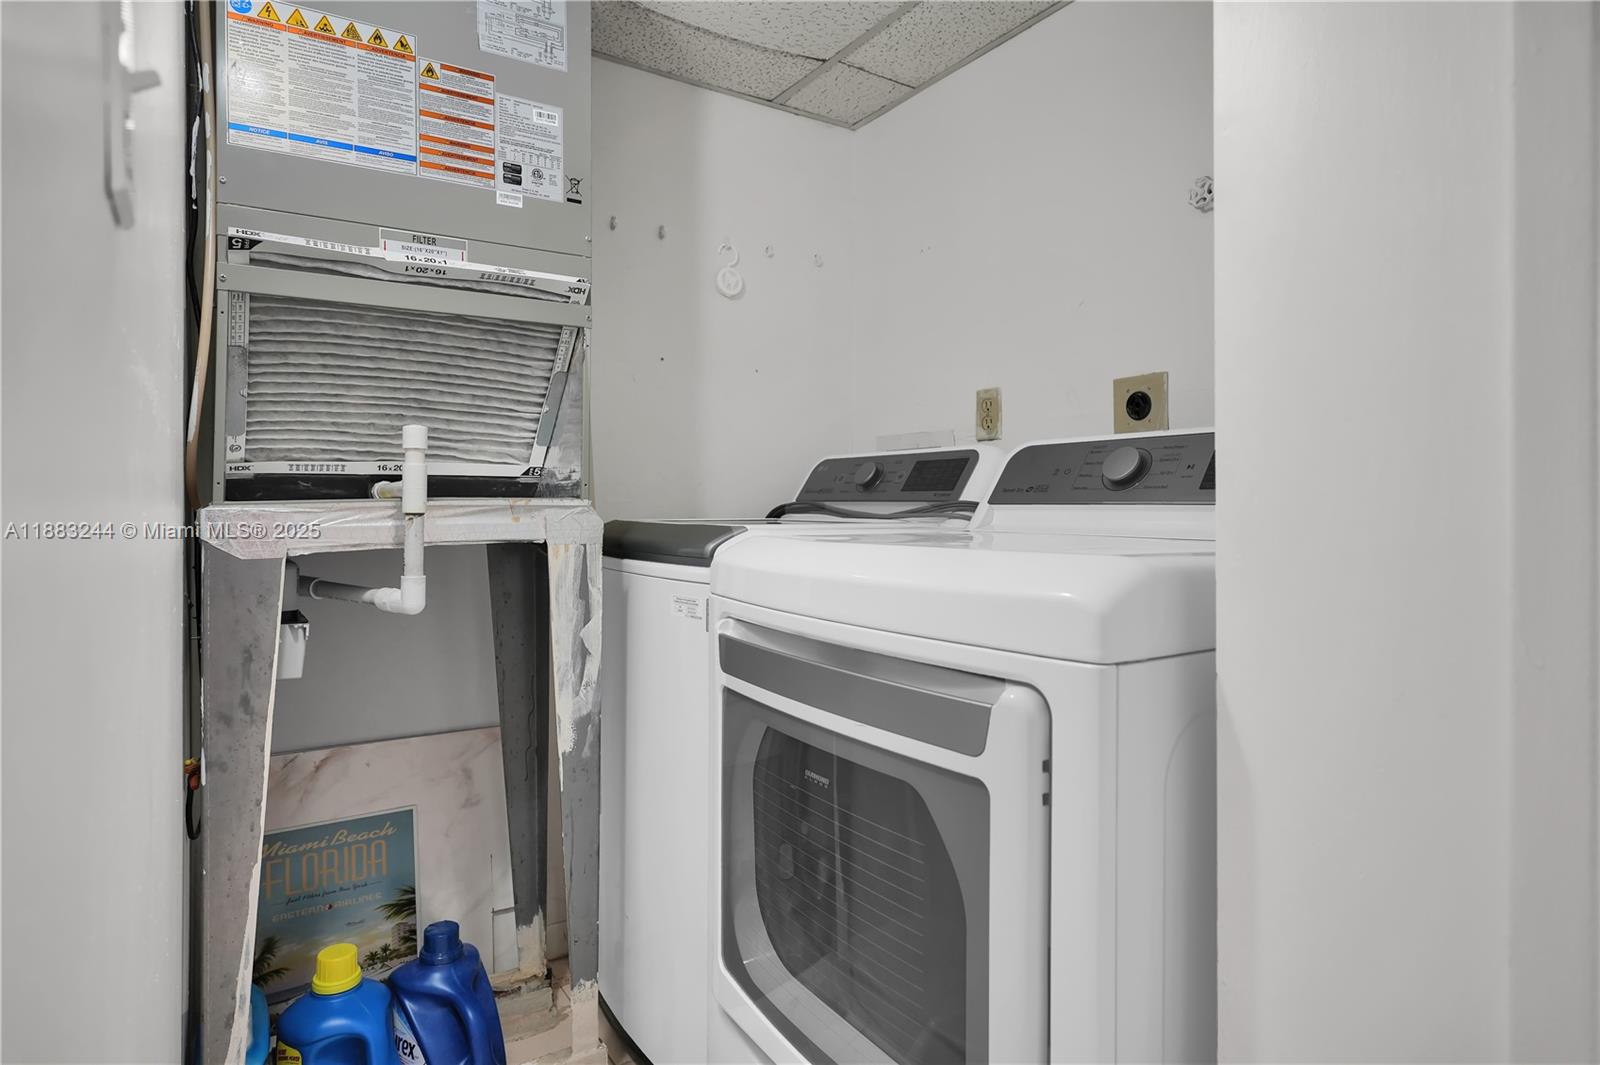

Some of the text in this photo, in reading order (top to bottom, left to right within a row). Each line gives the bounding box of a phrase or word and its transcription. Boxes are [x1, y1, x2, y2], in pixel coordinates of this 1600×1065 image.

[249, 127, 270, 135] NOTICE
[236, 229, 261, 237] HDX
[232, 238, 242, 249] 5
[412, 234, 437, 246] FILTER
[568, 286, 586, 295] HDX
[229, 464, 251, 472] HDX
[534, 467, 541, 476] 5
[263, 820, 399, 858] Miami Beach
[263, 839, 389, 898] FLORIDA
[272, 905, 323, 922] EASTERN
[395, 1034, 416, 1060] rex
